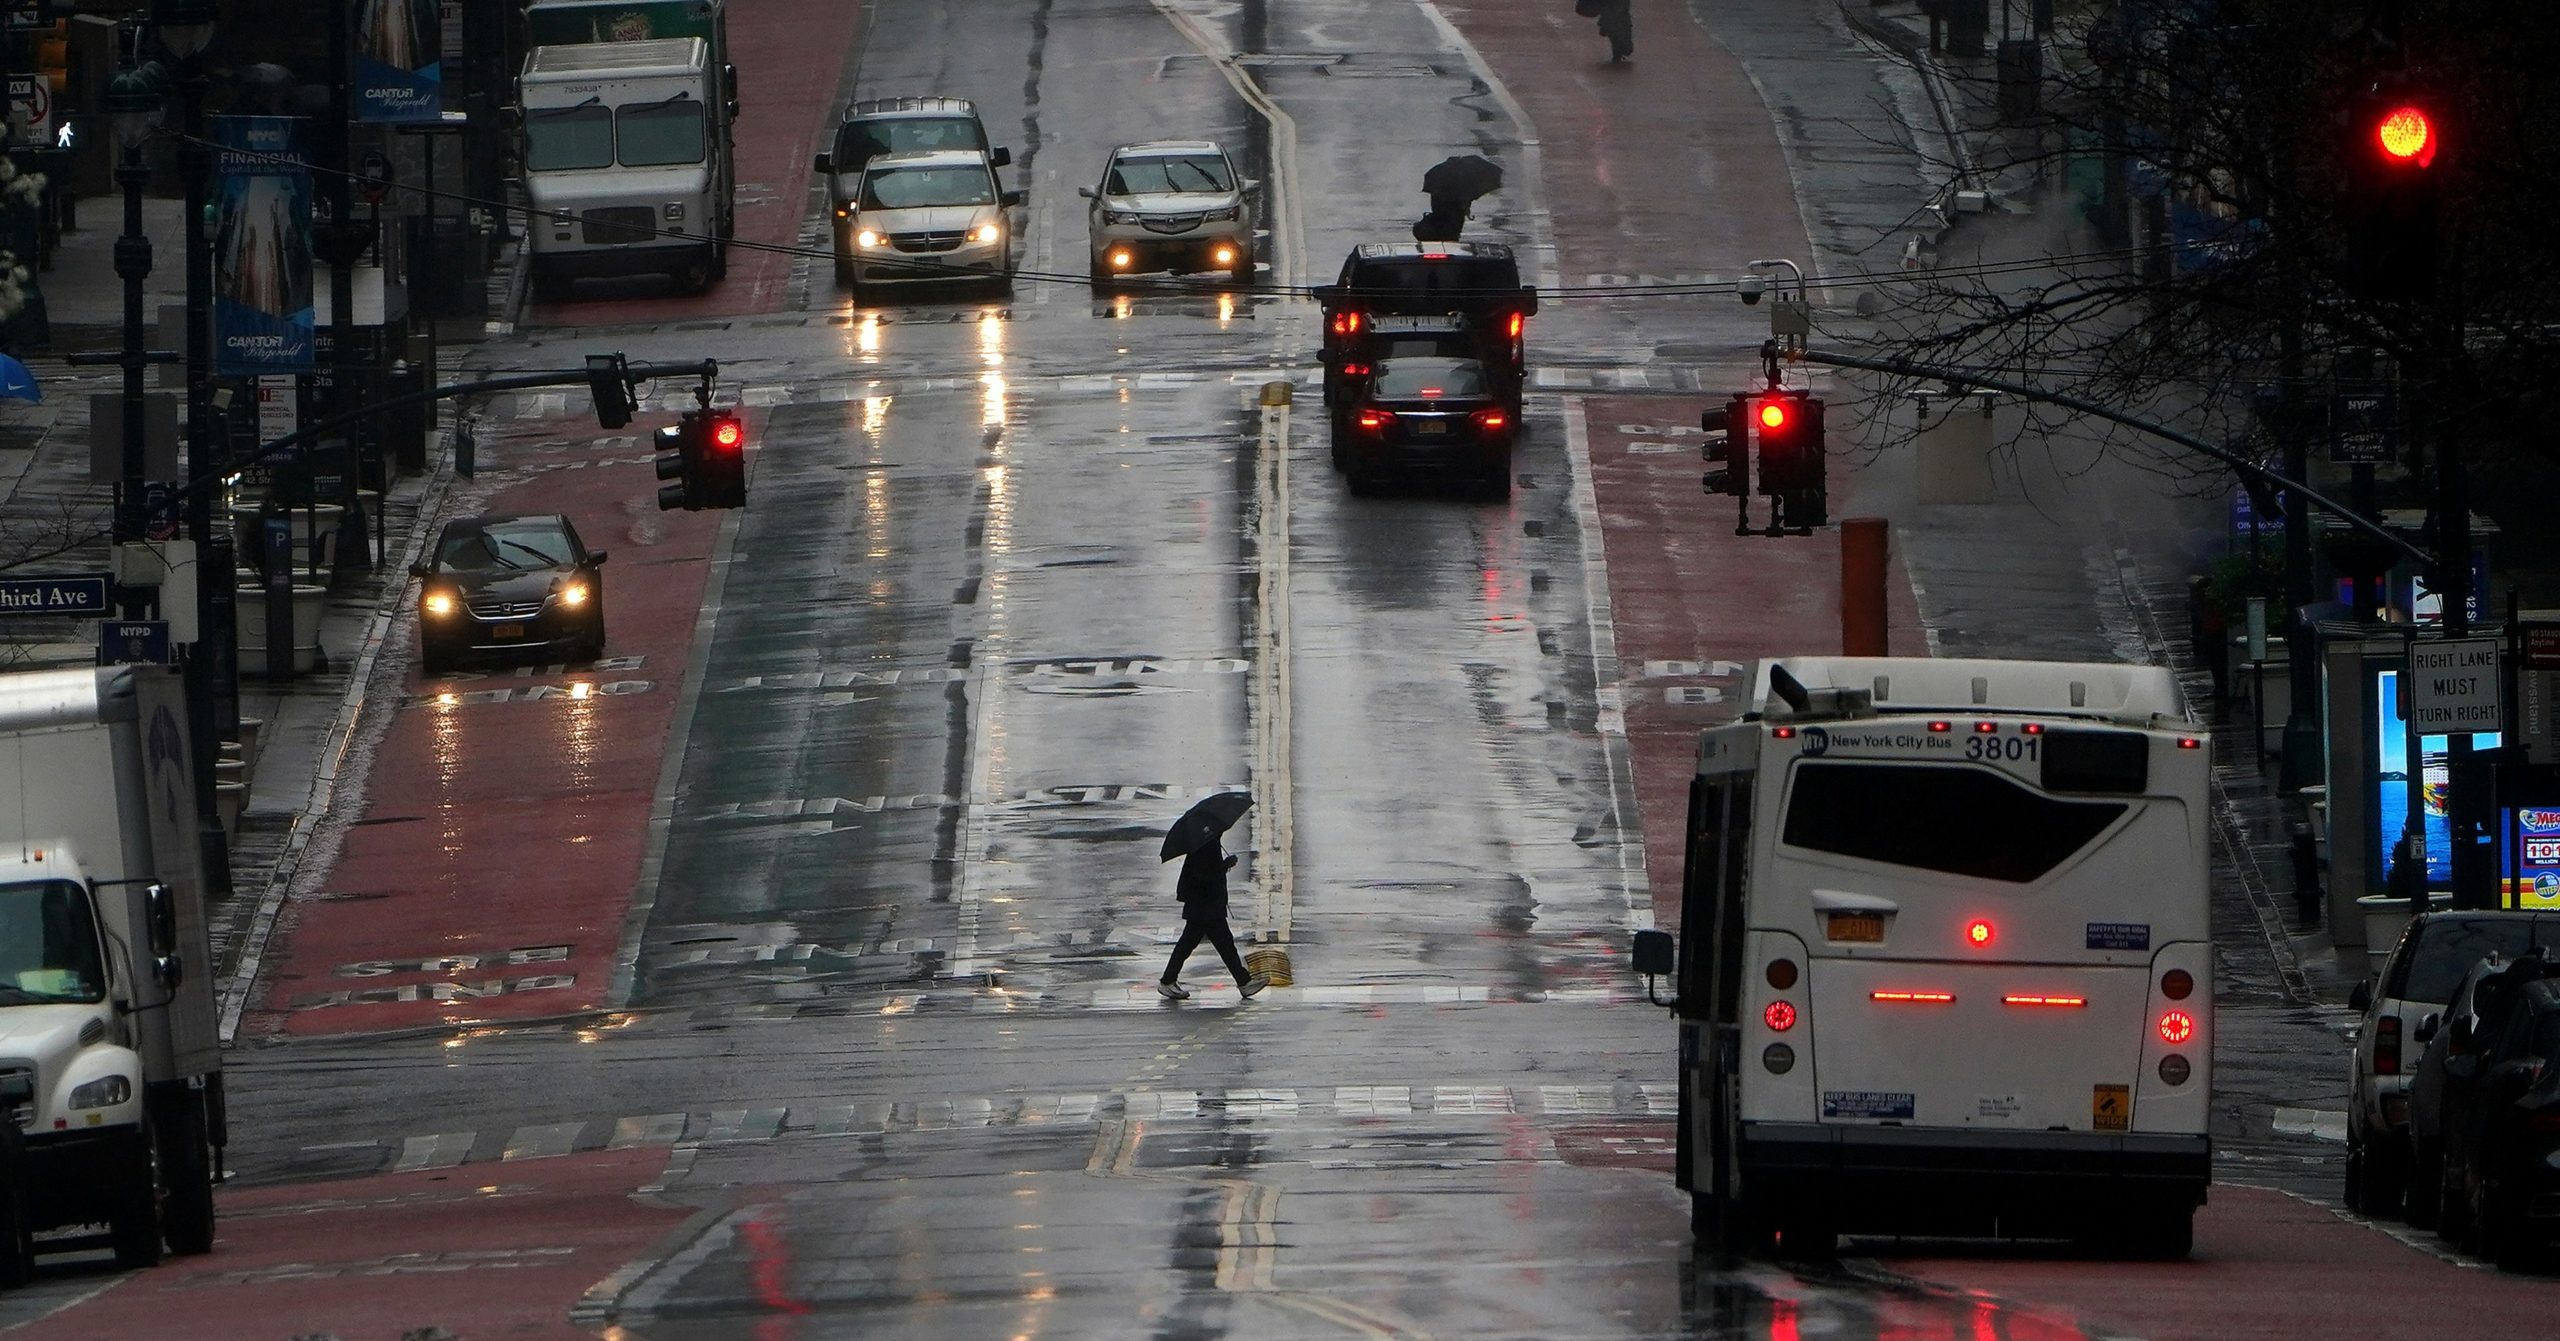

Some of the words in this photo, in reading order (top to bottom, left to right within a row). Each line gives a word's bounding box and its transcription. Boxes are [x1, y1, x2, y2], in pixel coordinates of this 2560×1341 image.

[10, 83, 26, 92] AY
[364, 88, 414, 99] CANTOR
[226, 336, 283, 347] CANTOR
[0, 588, 42, 606] hird
[48, 587, 88, 606] Ave
[120, 627, 151, 637] NYPD
[2416, 654, 2454, 668] RIGHT
[2460, 652, 2493, 667] LANE
[2434, 678, 2476, 696] MUST
[2528, 670, 2540, 734] ewsstand
[2418, 708, 2452, 722] TURN
[2457, 705, 2496, 720] RIGHT
[1832, 736, 1860, 747] New
[1864, 736, 1893, 747] York
[1896, 736, 1923, 749] City
[1927, 738, 1951, 748] Bus
[1965, 736, 2037, 761] 3801
[2536, 812, 2560, 825] MEG
